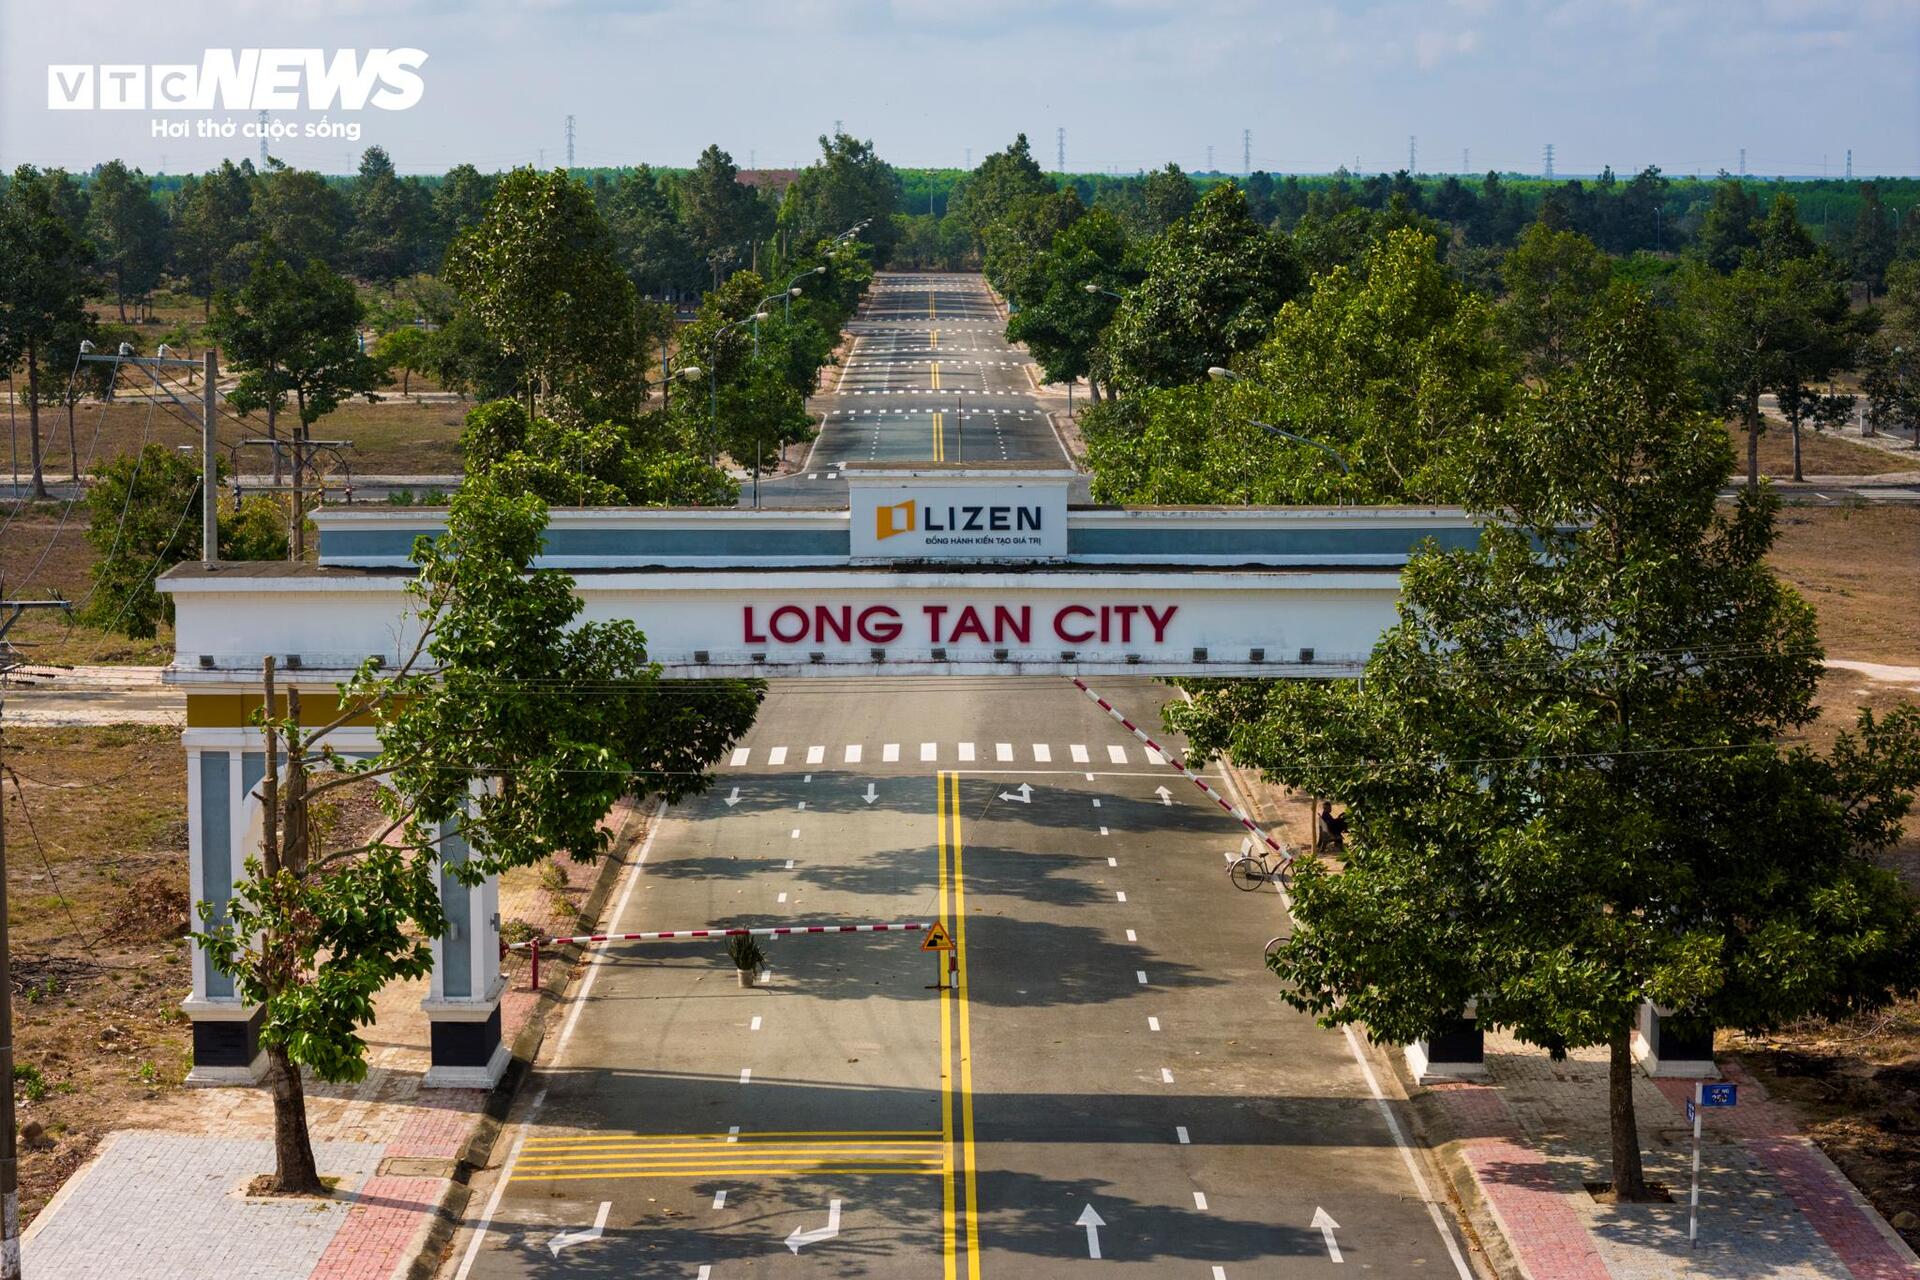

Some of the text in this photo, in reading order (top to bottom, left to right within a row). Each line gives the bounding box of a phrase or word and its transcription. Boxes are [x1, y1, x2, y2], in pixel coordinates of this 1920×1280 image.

[924, 506, 1042, 531] LIZEN
[743, 606, 1178, 643] LONG TAN CITY
